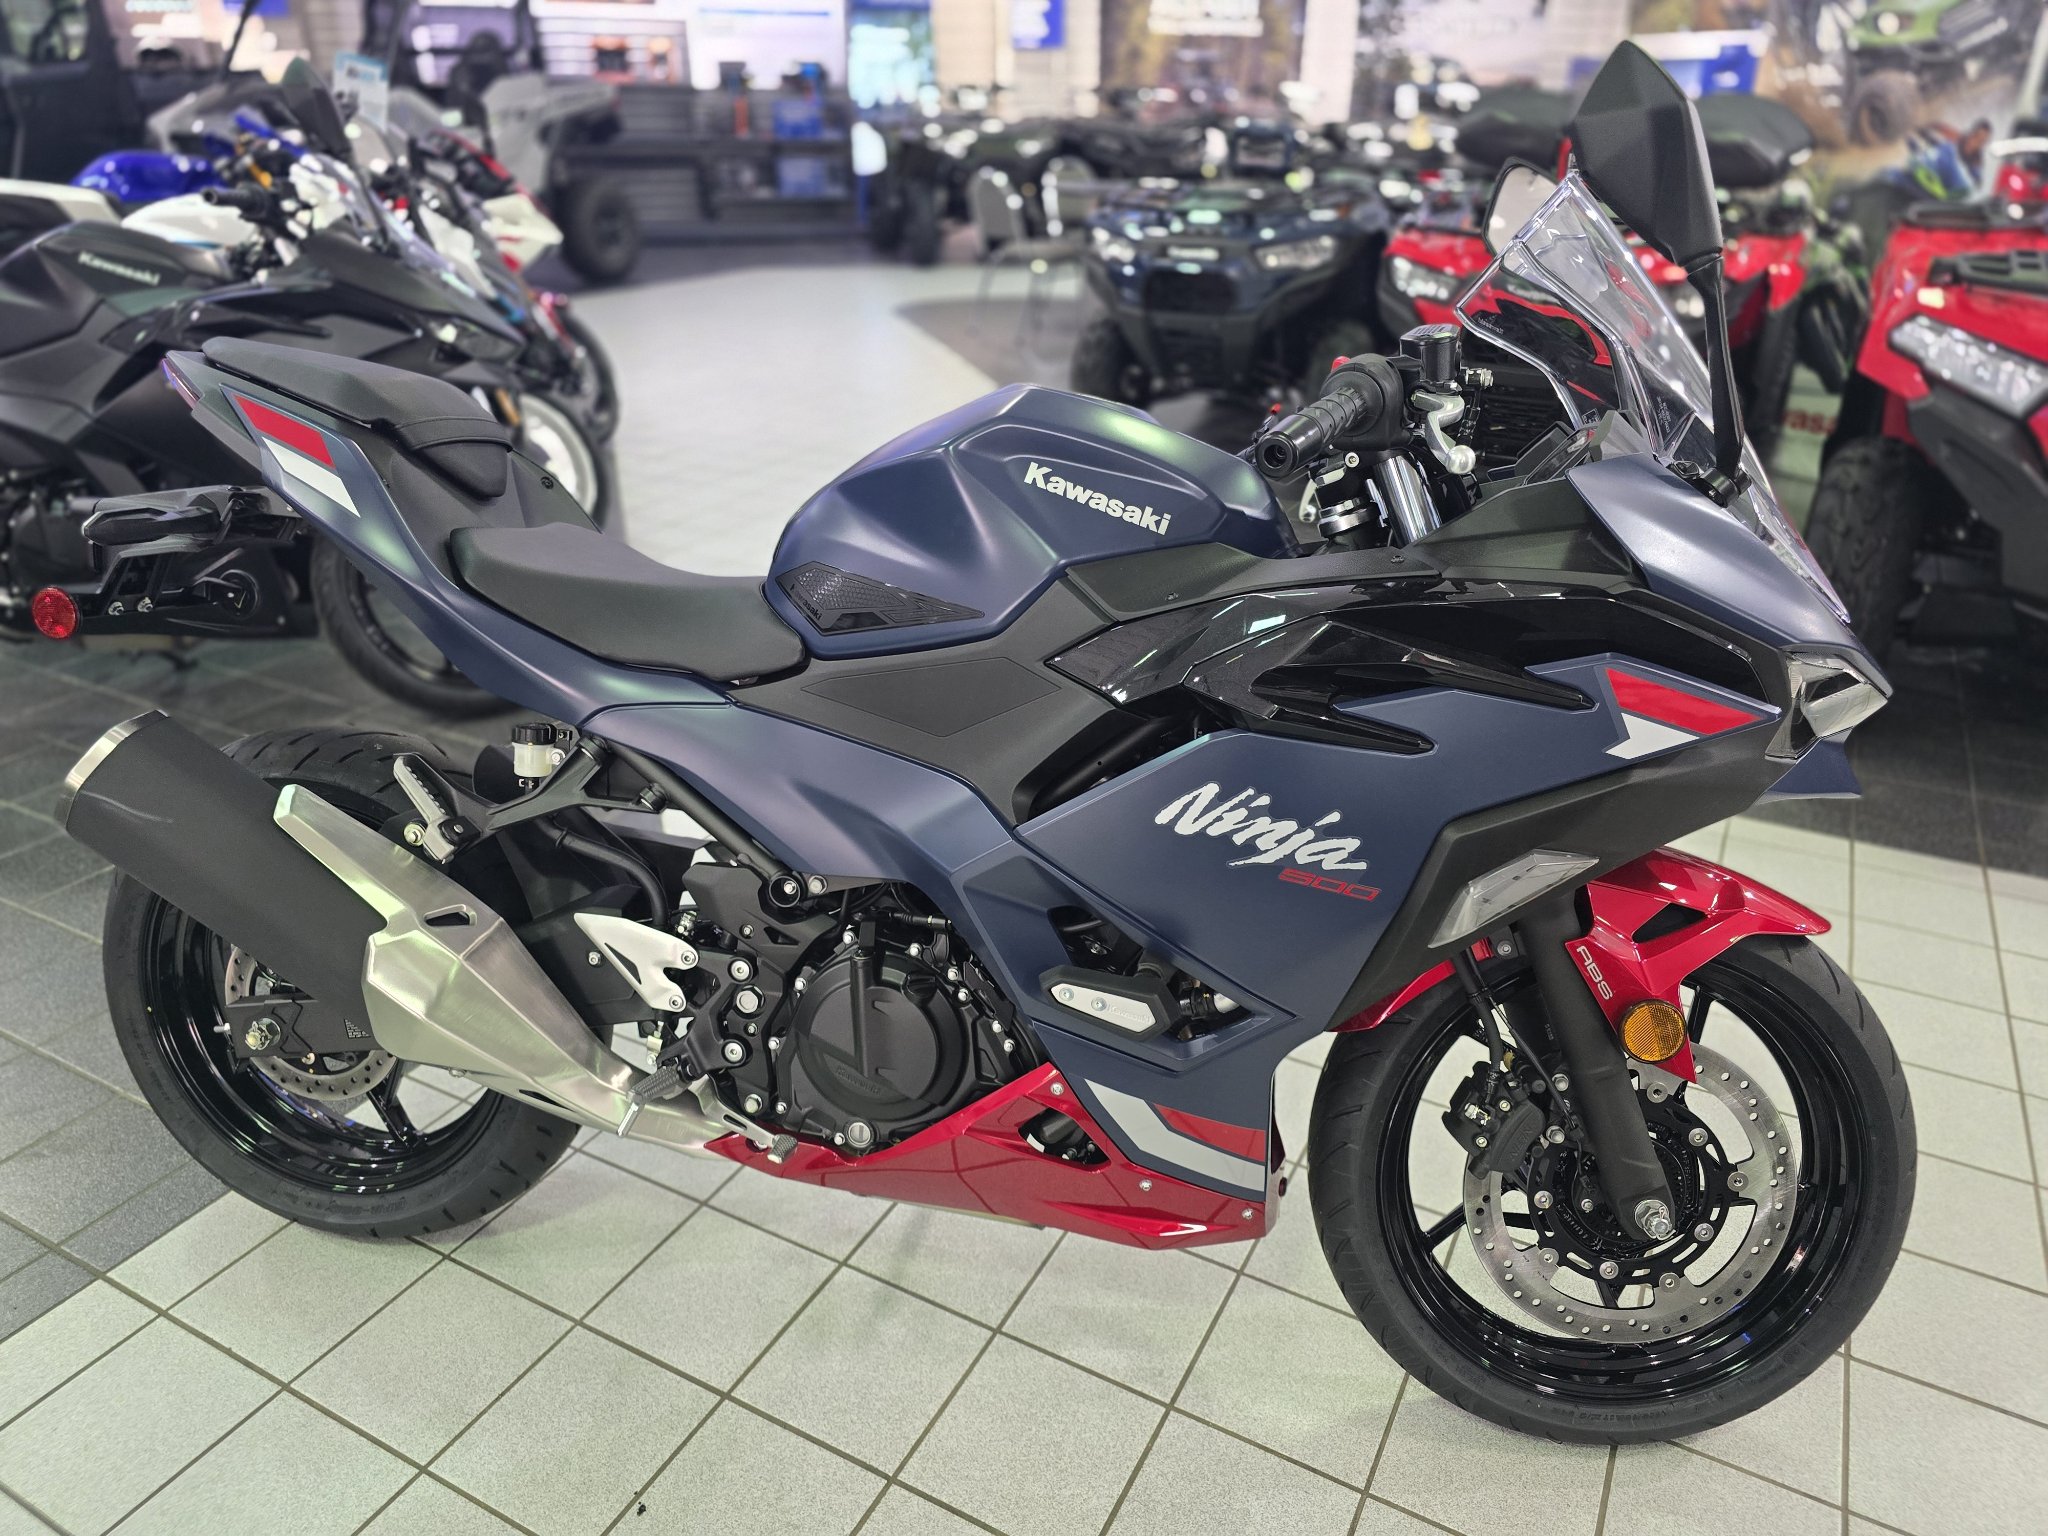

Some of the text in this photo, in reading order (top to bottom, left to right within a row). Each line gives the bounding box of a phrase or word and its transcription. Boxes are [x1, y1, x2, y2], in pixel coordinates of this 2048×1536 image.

[79, 250, 161, 287] Kawasaki
[1023, 461, 1172, 536] Kawasaki
[1154, 782, 1368, 870] Ninja
[1278, 868, 1382, 901] 500
[1576, 945, 1613, 1000] ABS
